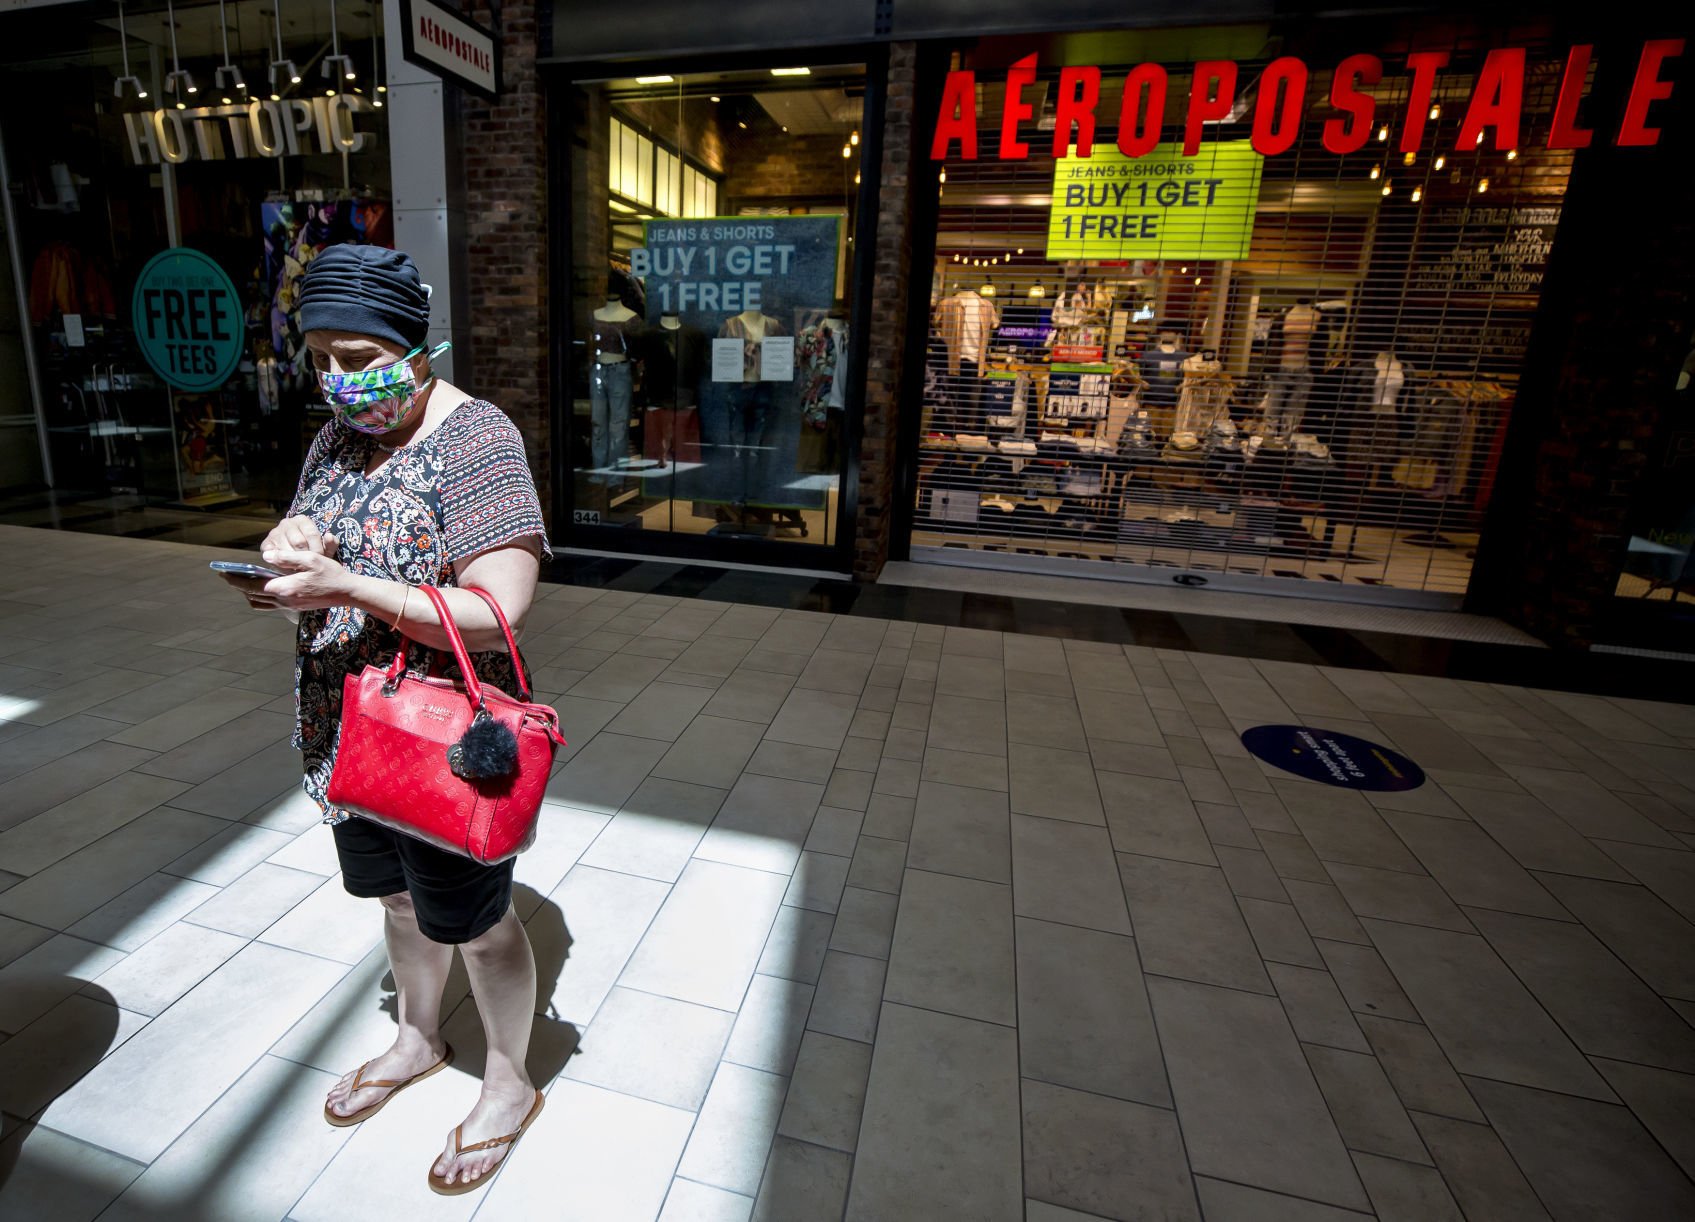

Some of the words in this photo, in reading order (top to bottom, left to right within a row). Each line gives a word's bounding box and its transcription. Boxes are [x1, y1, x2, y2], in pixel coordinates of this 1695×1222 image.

[931, 38, 1684, 160] AÉROPOSTALE
[1068, 165, 1115, 178] JEANS
[1120, 165, 1128, 176] &
[1133, 163, 1195, 176] SHORTS
[1065, 182, 1130, 207] BUY
[1137, 182, 1148, 207] 1
[1156, 180, 1223, 207] GET
[649, 227, 697, 242] JEANS
[700, 226, 711, 240] &
[713, 225, 775, 240] SHORTS
[1062, 215, 1072, 238] 1
[1080, 214, 1159, 239] FREE
[631, 246, 697, 277] BUY
[704, 246, 716, 276] 1
[725, 244, 795, 276] GET
[658, 282, 671, 312] 1
[679, 281, 762, 312] FREE
[144, 289, 230, 341] FREE
[165, 344, 217, 375] TEES
[575, 511, 599, 524] 344
